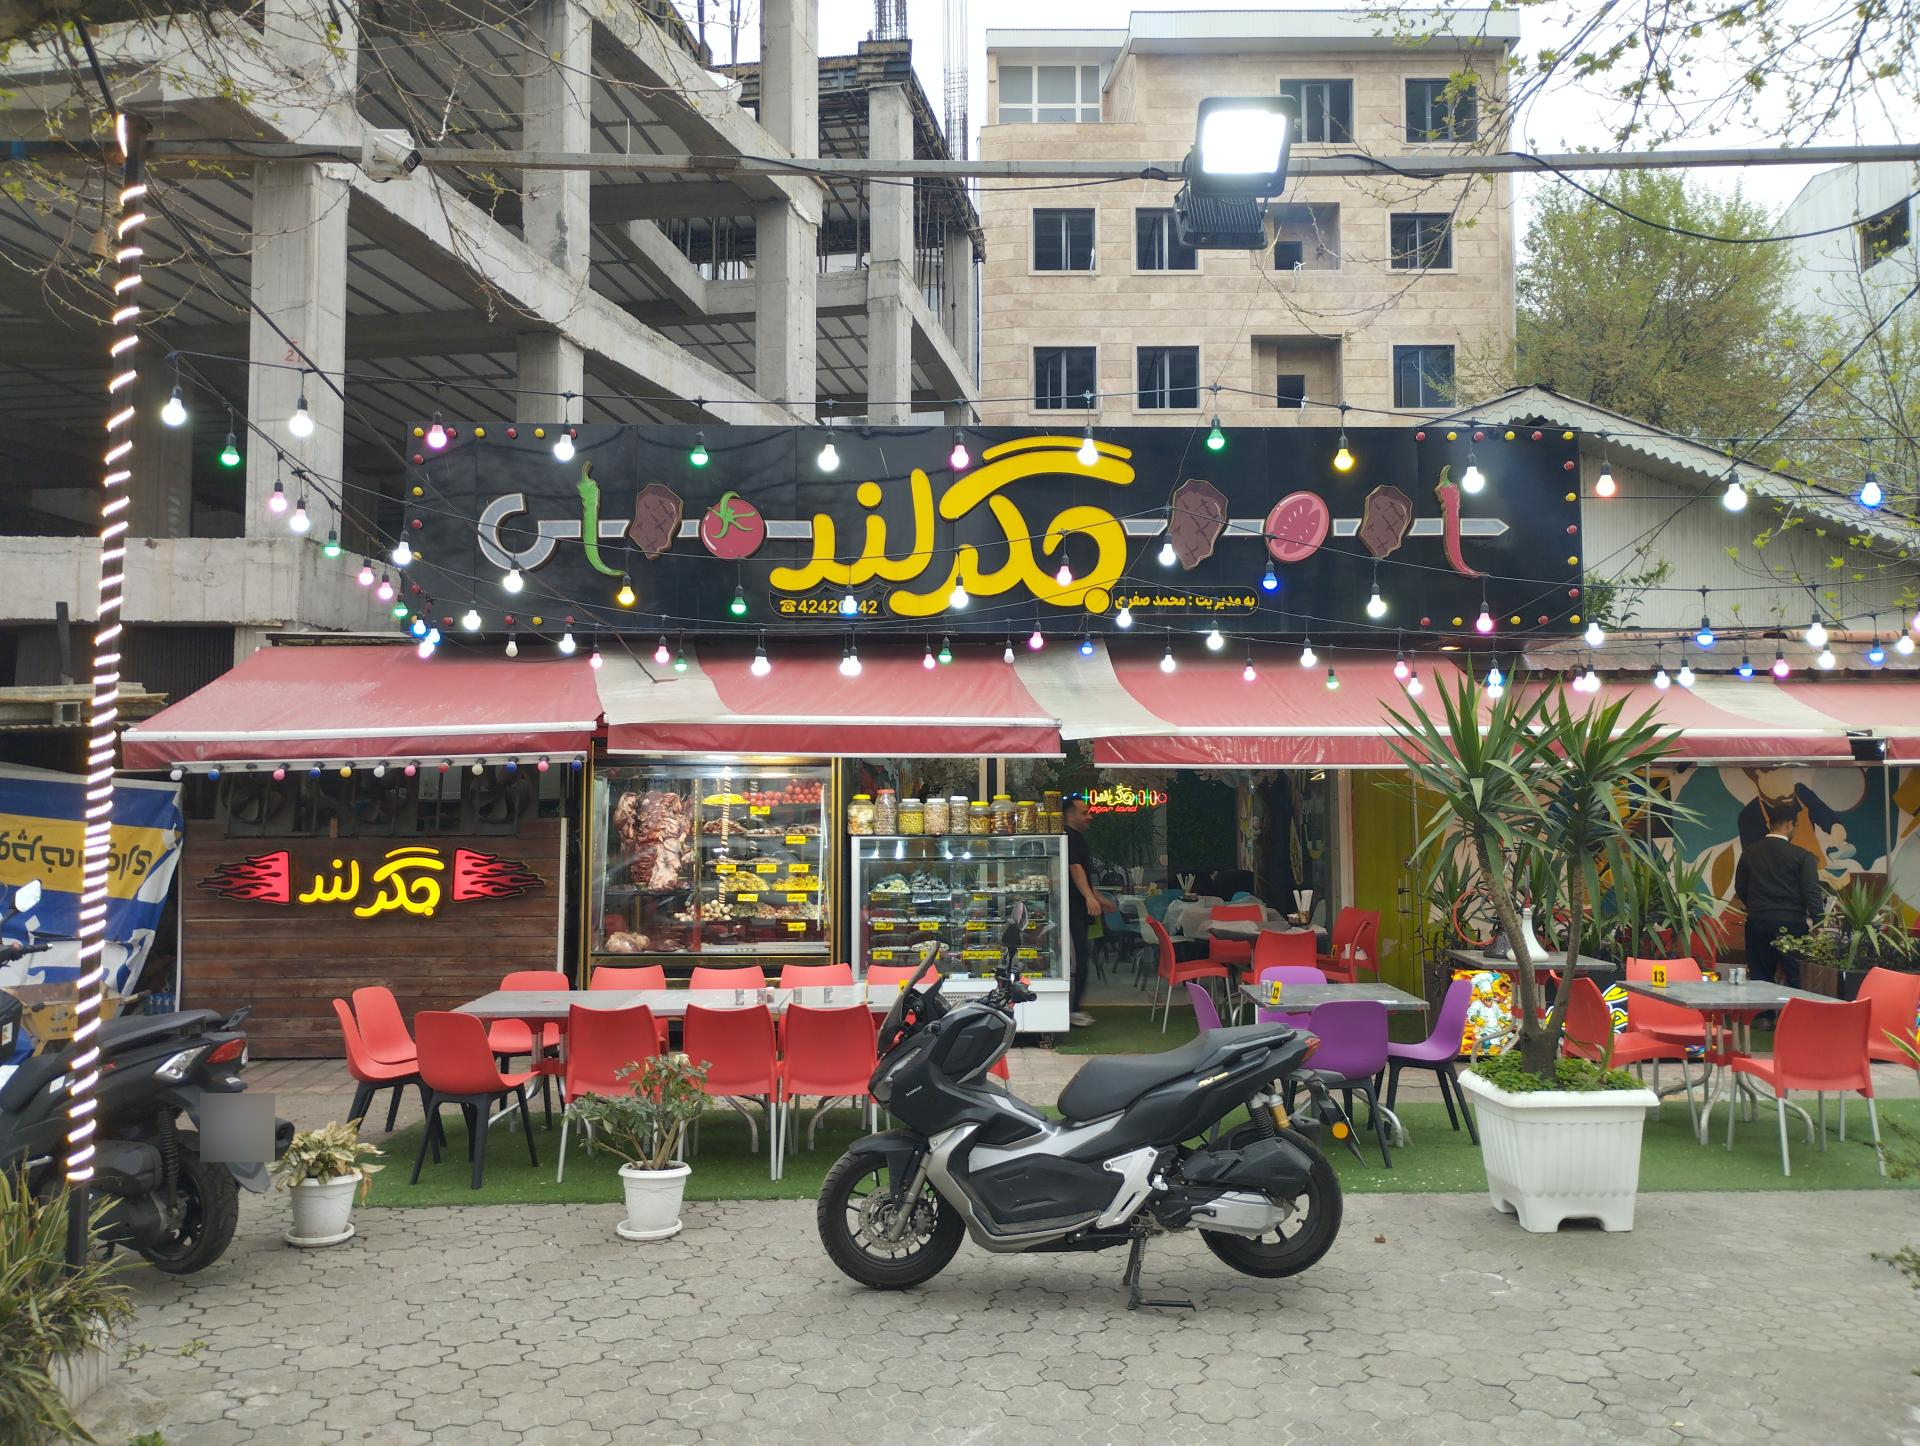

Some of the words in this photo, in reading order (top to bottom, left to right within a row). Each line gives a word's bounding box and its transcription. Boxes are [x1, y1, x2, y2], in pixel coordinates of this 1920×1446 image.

[769, 468, 935, 591] لند
[889, 436, 1136, 617] جگر
[798, 599, 878, 614] 4242042
[1153, 595, 1186, 607] محمد
[1195, 596, 1241, 611] مدیریت
[1243, 595, 1256, 610] به
[298, 859, 361, 903] لند
[353, 846, 445, 918] جگر
[1653, 970, 1665, 983] 13
[1272, 986, 1280, 999] 12
